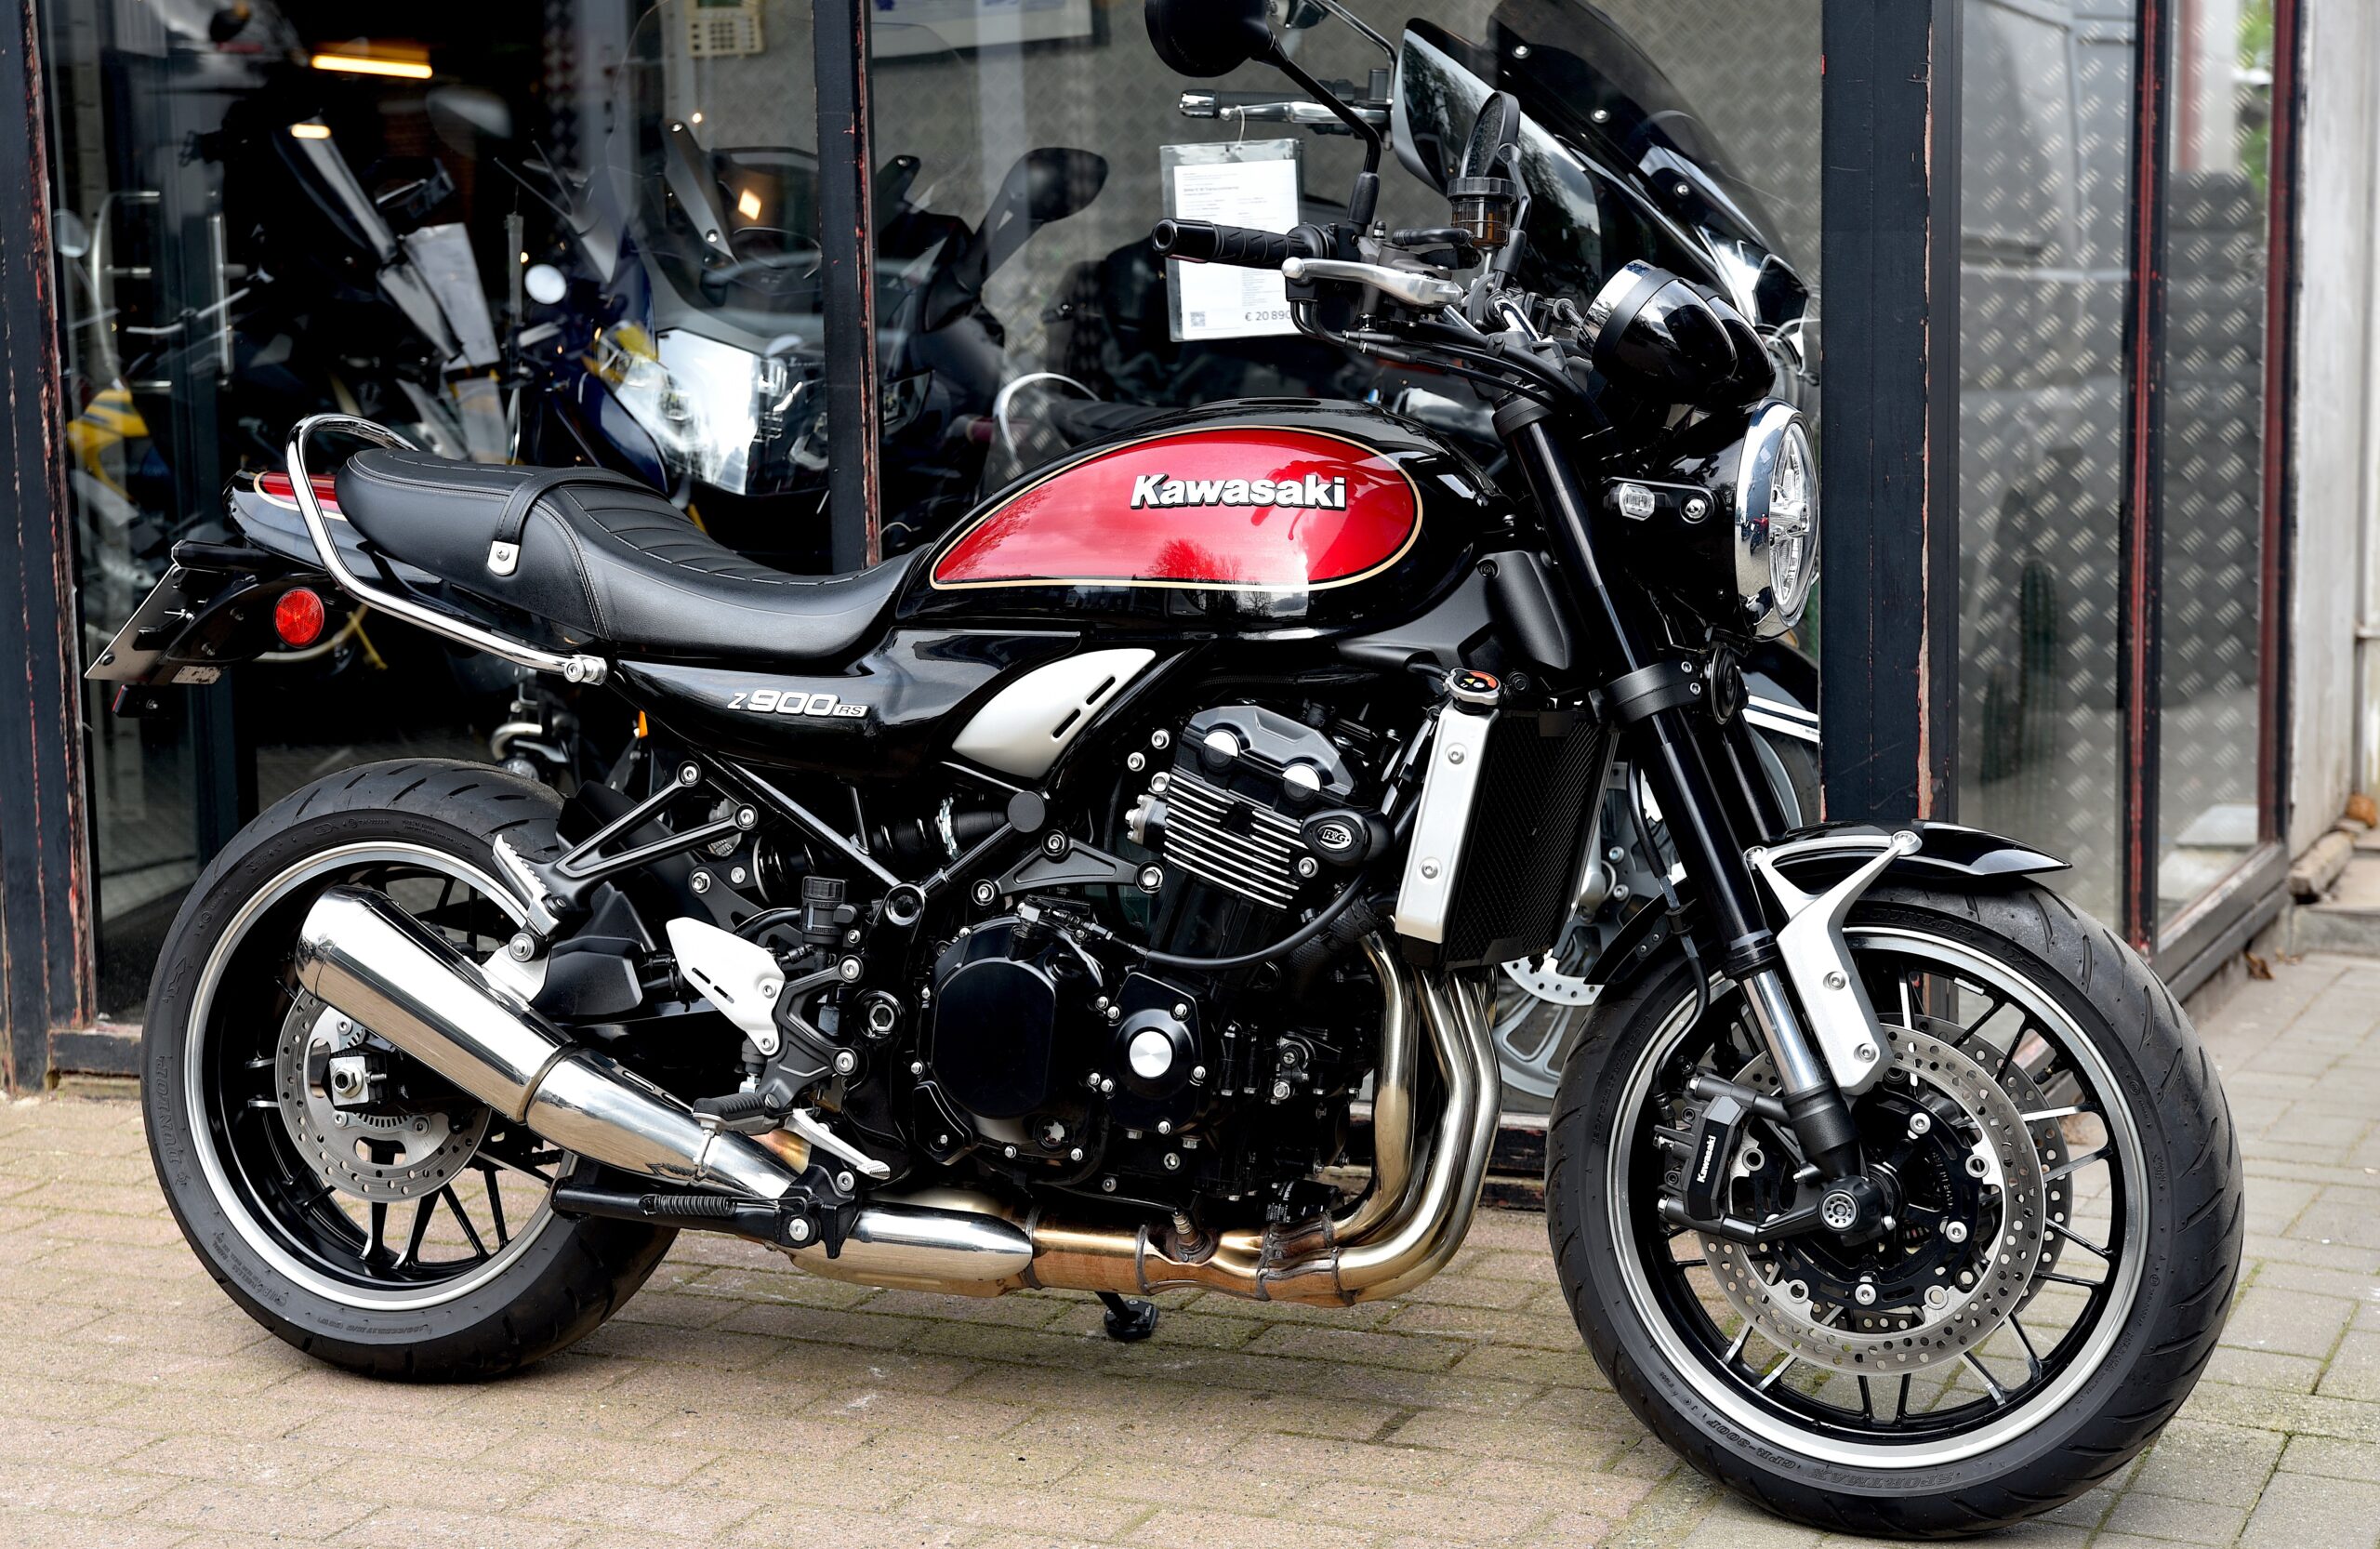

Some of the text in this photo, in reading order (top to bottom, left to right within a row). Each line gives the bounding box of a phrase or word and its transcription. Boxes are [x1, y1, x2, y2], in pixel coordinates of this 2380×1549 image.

[1130, 473, 1346, 510] Kawasaki
[1323, 829, 1347, 842] R&G
[155, 1055, 183, 1164] DUNLOP
[1696, 1134, 1717, 1184] Kawasaki
[1705, 1419, 1796, 1470] GPR-300F
[1811, 1468, 1954, 1489] SPORTMAX
